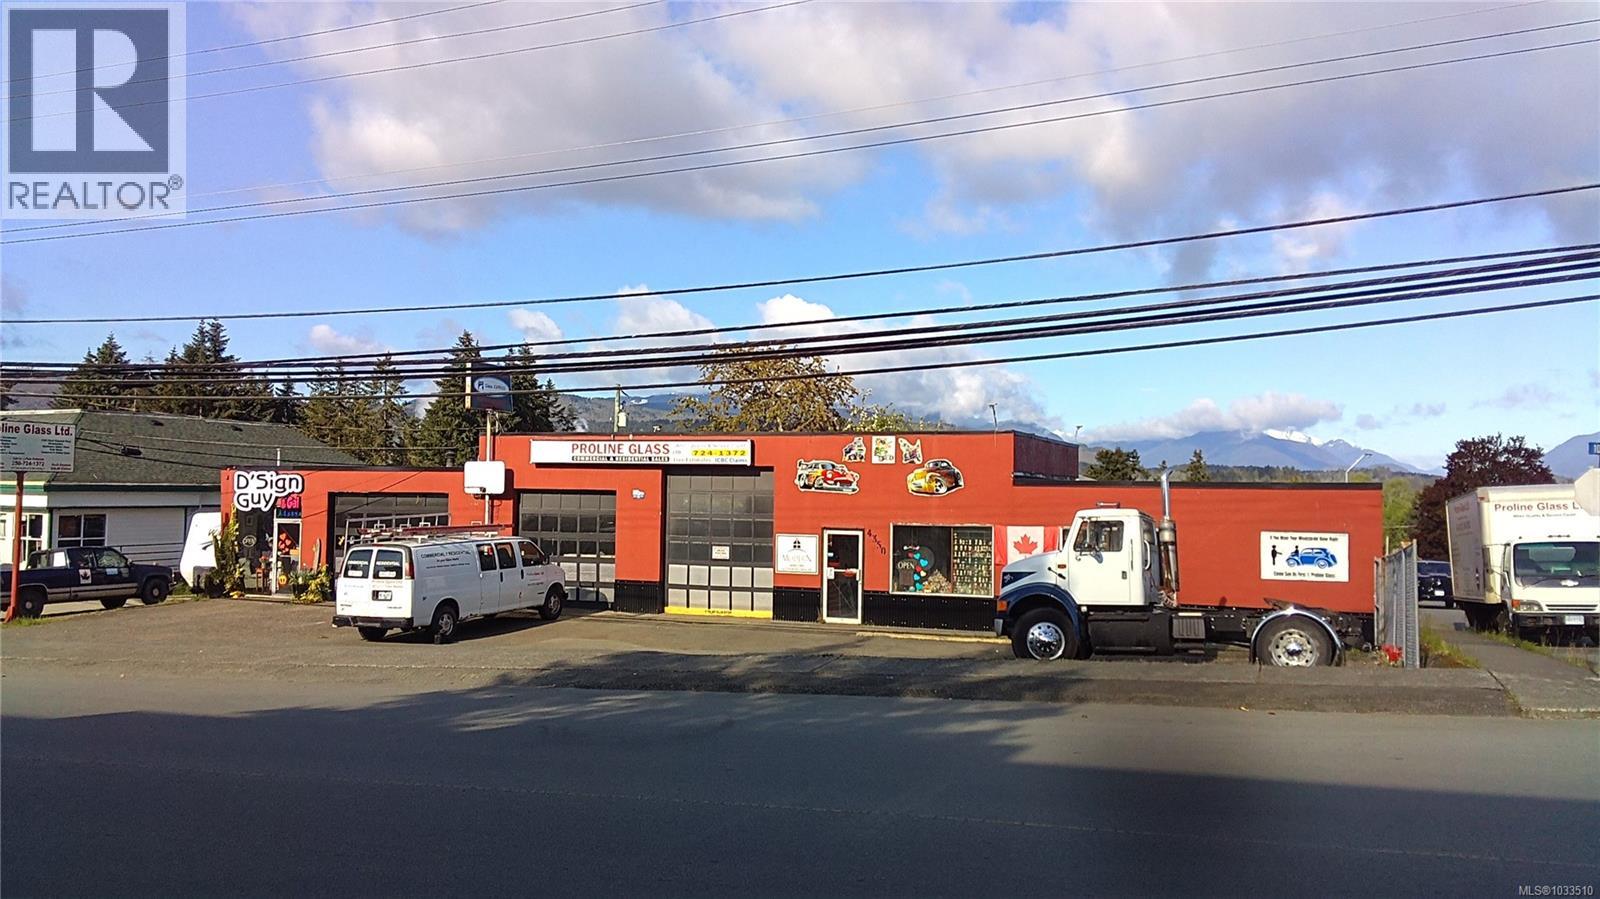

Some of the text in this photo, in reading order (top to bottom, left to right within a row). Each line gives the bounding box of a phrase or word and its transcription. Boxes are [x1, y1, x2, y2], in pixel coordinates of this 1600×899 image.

[0, 423, 73, 436] line Glass Ltd.
[571, 443, 625, 454] PROLINE
[628, 443, 670, 455] GLASS
[236, 473, 299, 493] D'Sign
[236, 492, 273, 508] Guy
[1494, 502, 1533, 512] Proline
[1536, 501, 1569, 511] Glass
[897, 561, 915, 569] OPEN
